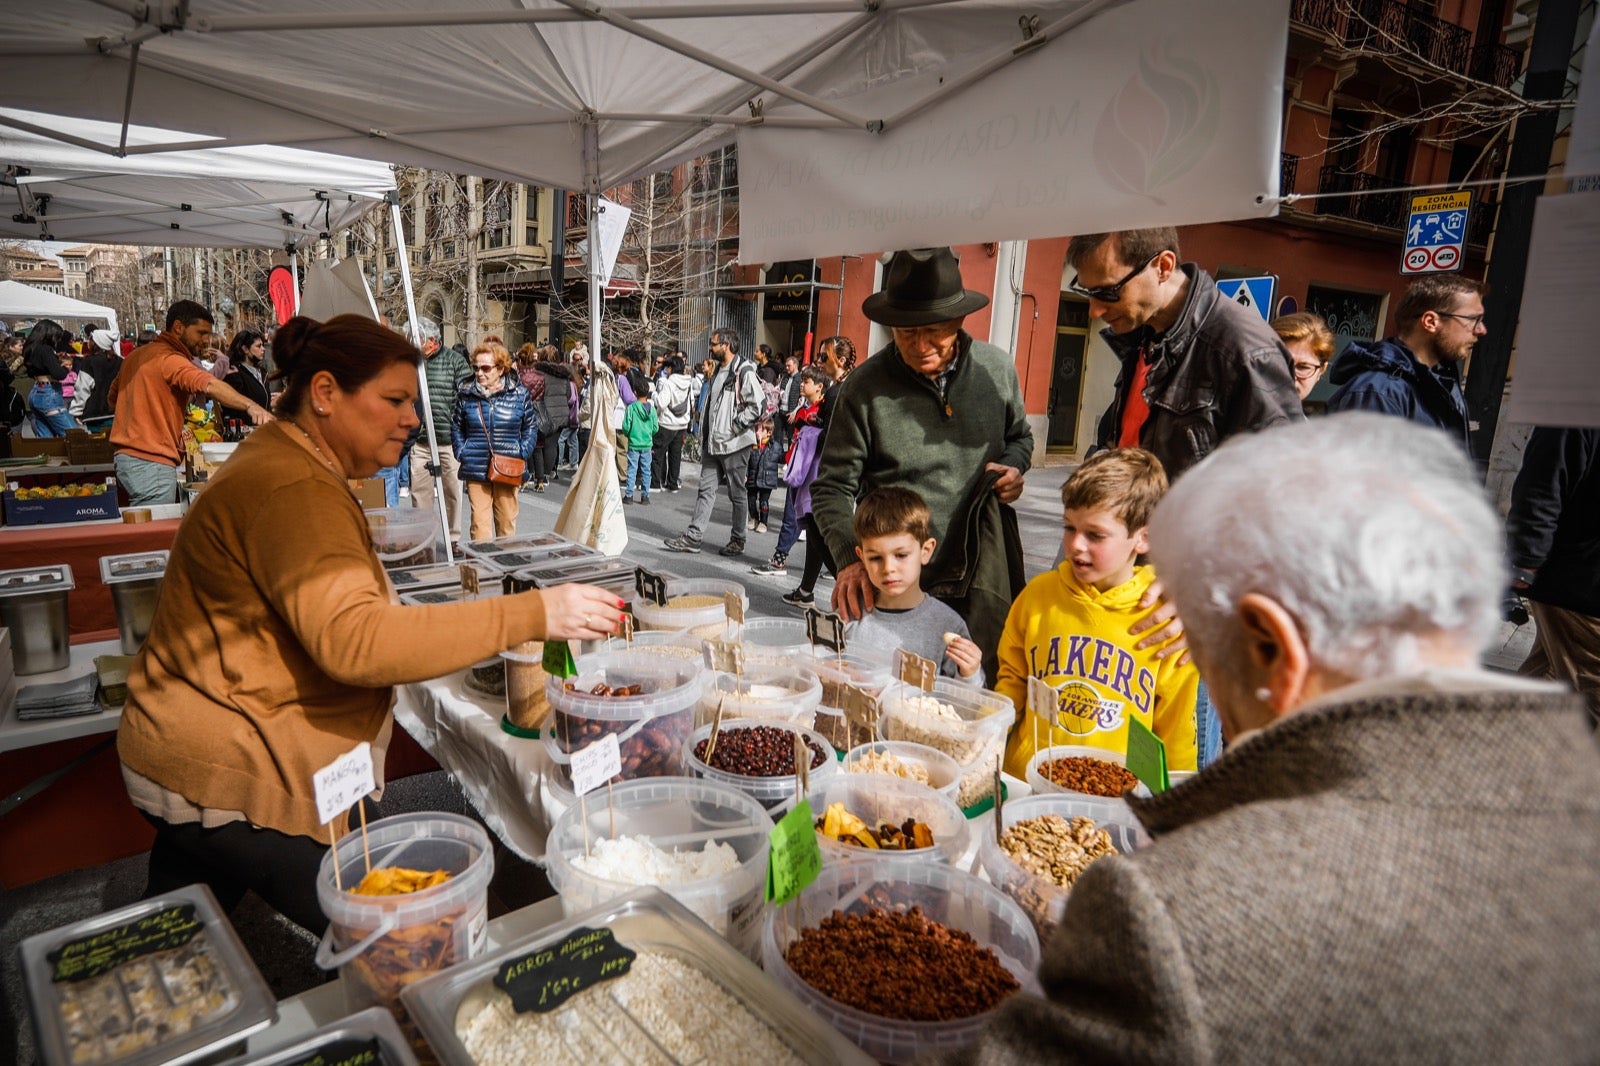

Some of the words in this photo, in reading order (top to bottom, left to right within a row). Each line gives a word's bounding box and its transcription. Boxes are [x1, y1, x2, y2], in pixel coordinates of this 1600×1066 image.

[1427, 194, 1455, 204] ZONA
[1411, 202, 1469, 213] RESIDENCIAL
[1410, 255, 1426, 264] 20
[76, 507, 105, 516] AROMA
[1030, 636, 1155, 713] LAKERS
[1066, 692, 1081, 700] LOS
[1057, 689, 1117, 729] AKERS
[504, 950, 555, 984] ARROZ
